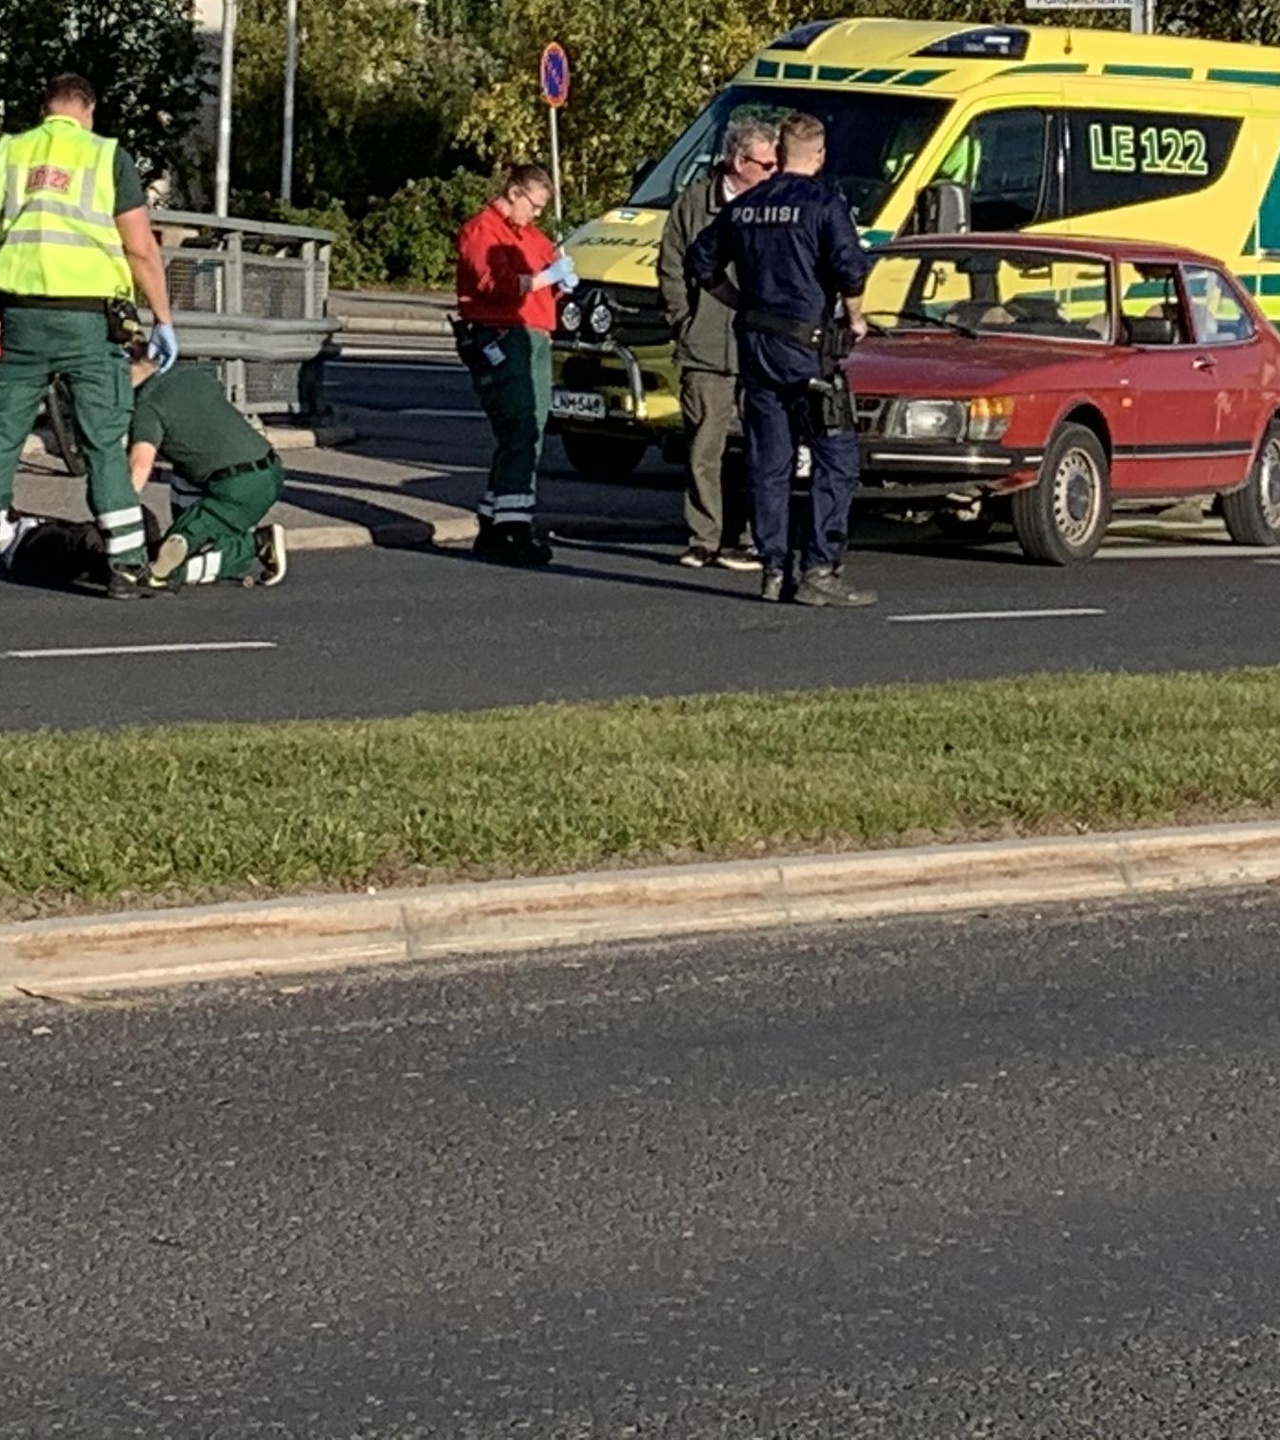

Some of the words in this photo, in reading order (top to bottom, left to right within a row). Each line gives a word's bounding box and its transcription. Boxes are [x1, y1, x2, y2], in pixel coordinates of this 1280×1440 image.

[1089, 123, 1136, 172] LE
[1140, 126, 1209, 176] 122
[731, 205, 801, 224] POLIISI
